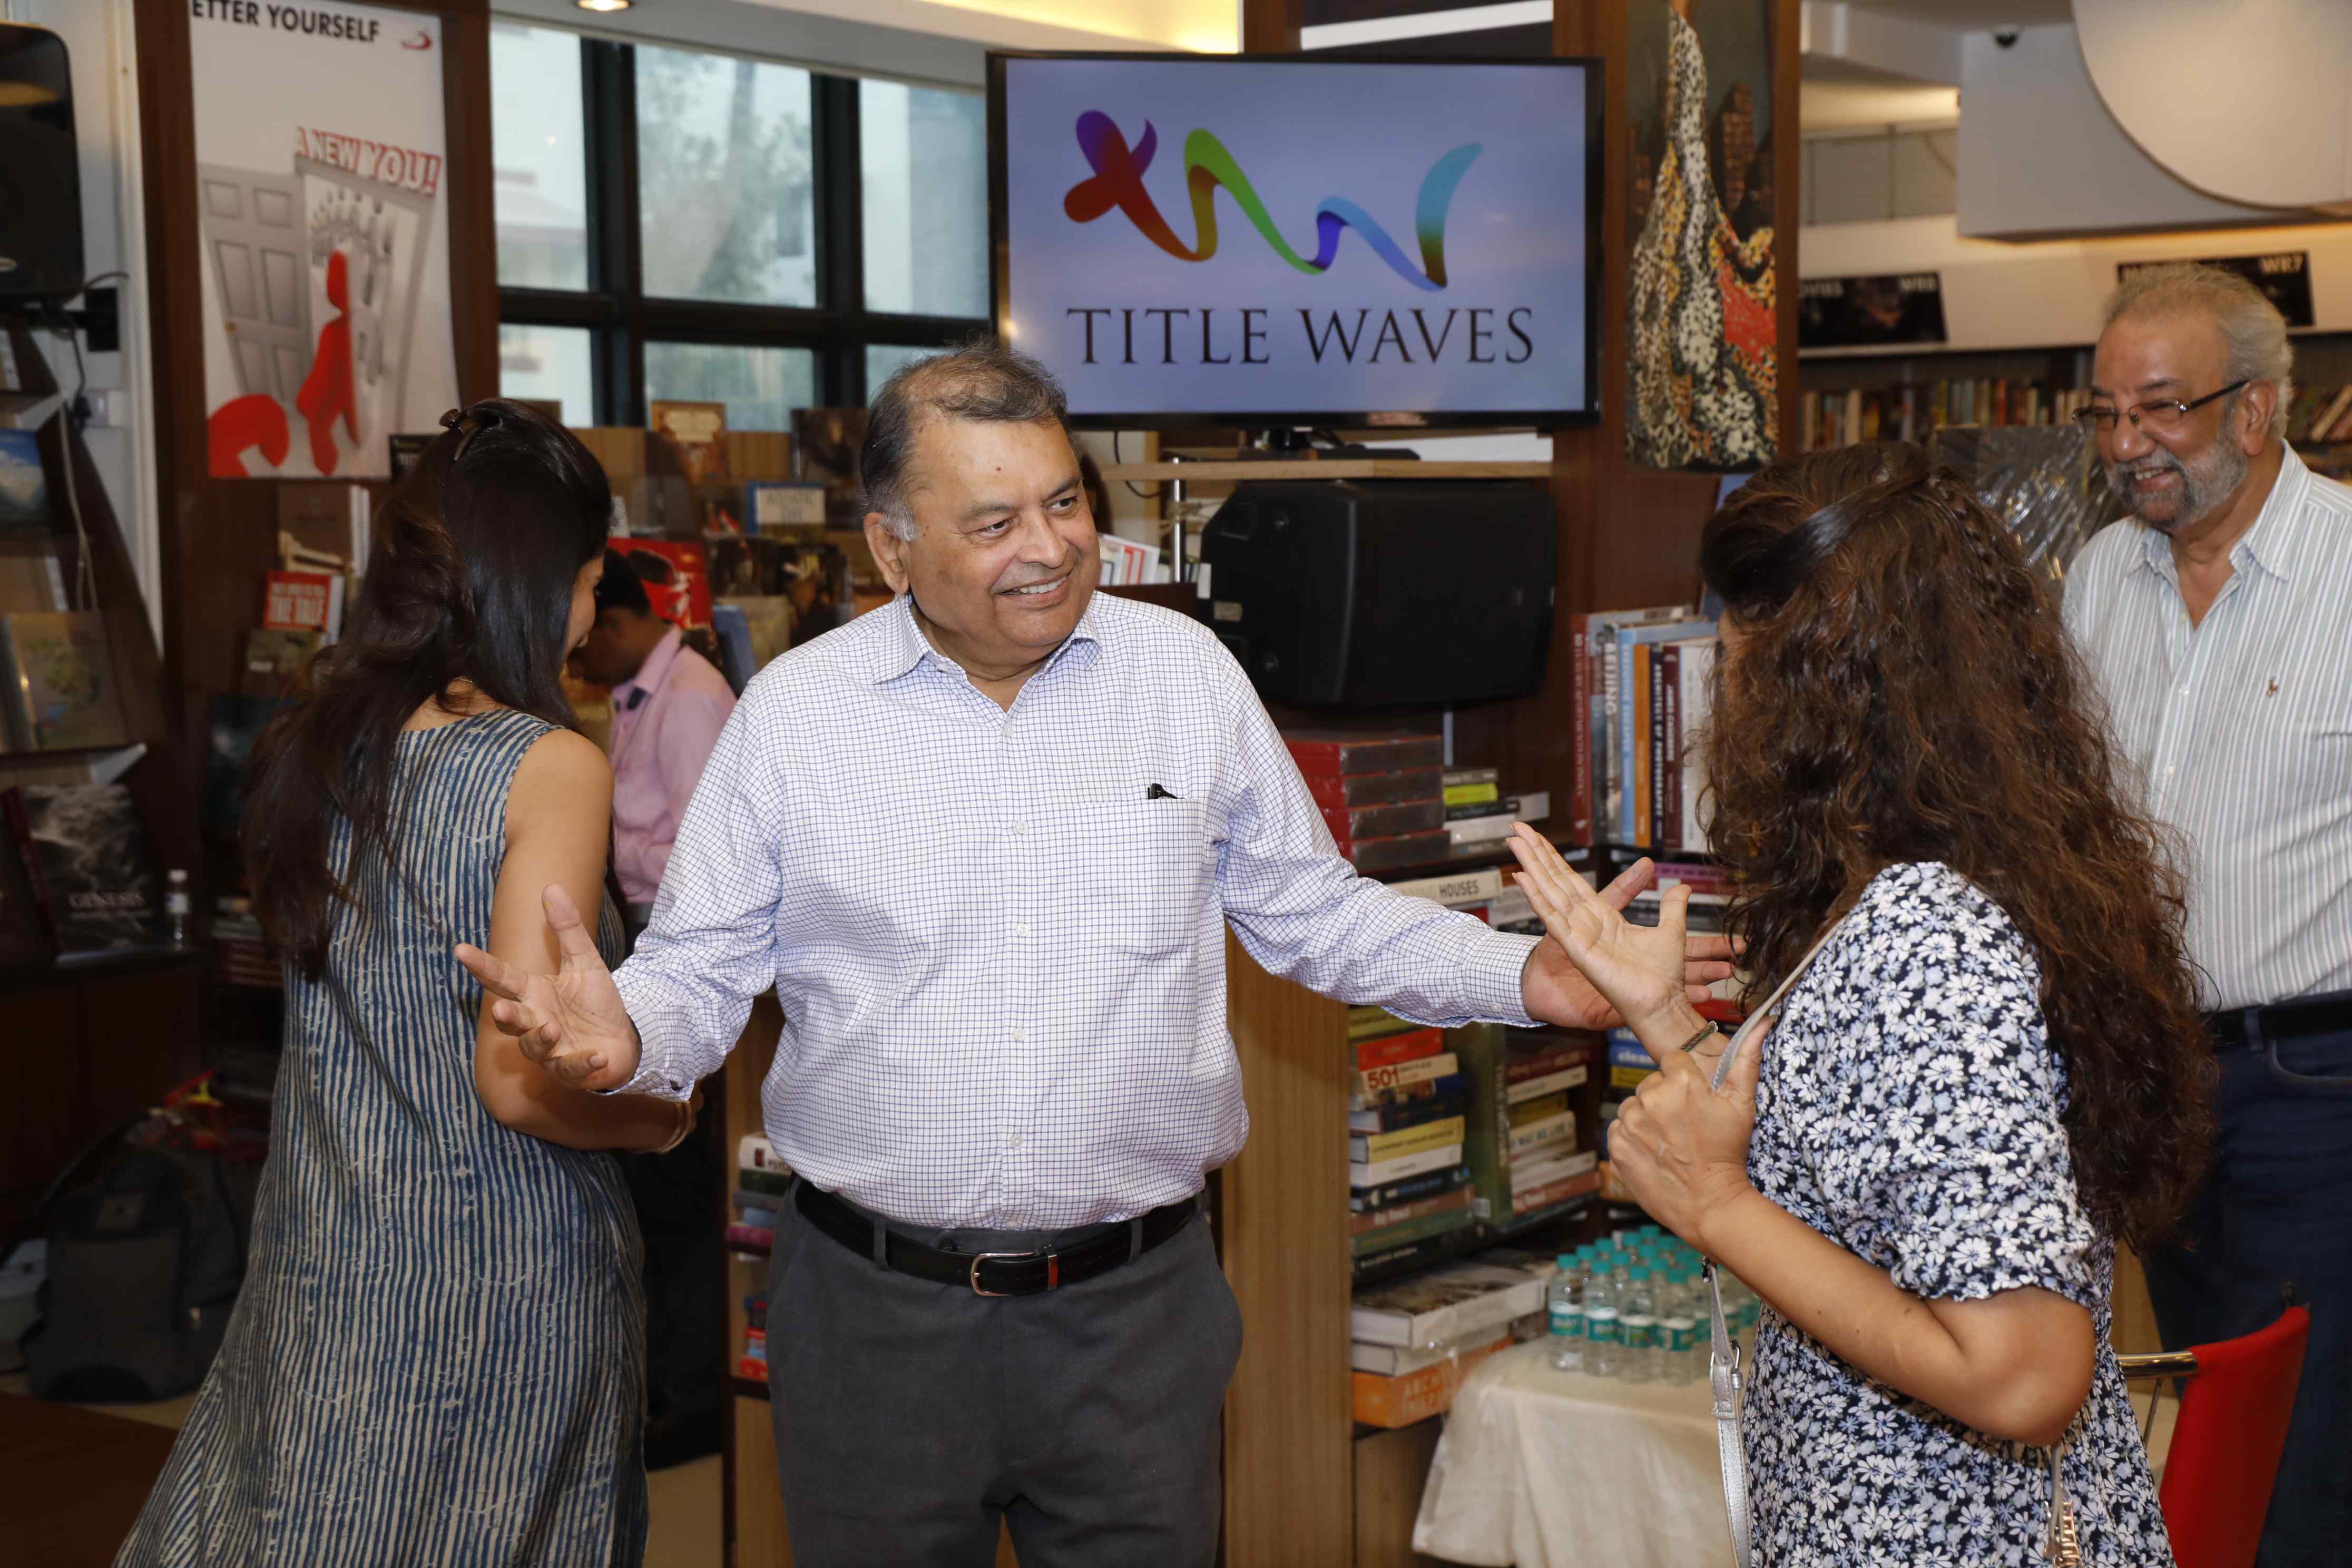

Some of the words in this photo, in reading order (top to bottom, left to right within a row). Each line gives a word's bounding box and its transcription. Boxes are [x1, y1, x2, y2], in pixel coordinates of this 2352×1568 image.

[192, 0, 260, 27] ETTER
[266, 5, 380, 43] YOURSELF
[310, 129, 362, 174] NEW
[360, 139, 442, 198] YOU!
[1067, 308, 1270, 364] TITLE
[1297, 307, 1533, 364] WAVES
[1604, 642, 1618, 716] BEIJING
[1439, 879, 1480, 898] HOUSES
[1367, 1067, 1399, 1089] 501
